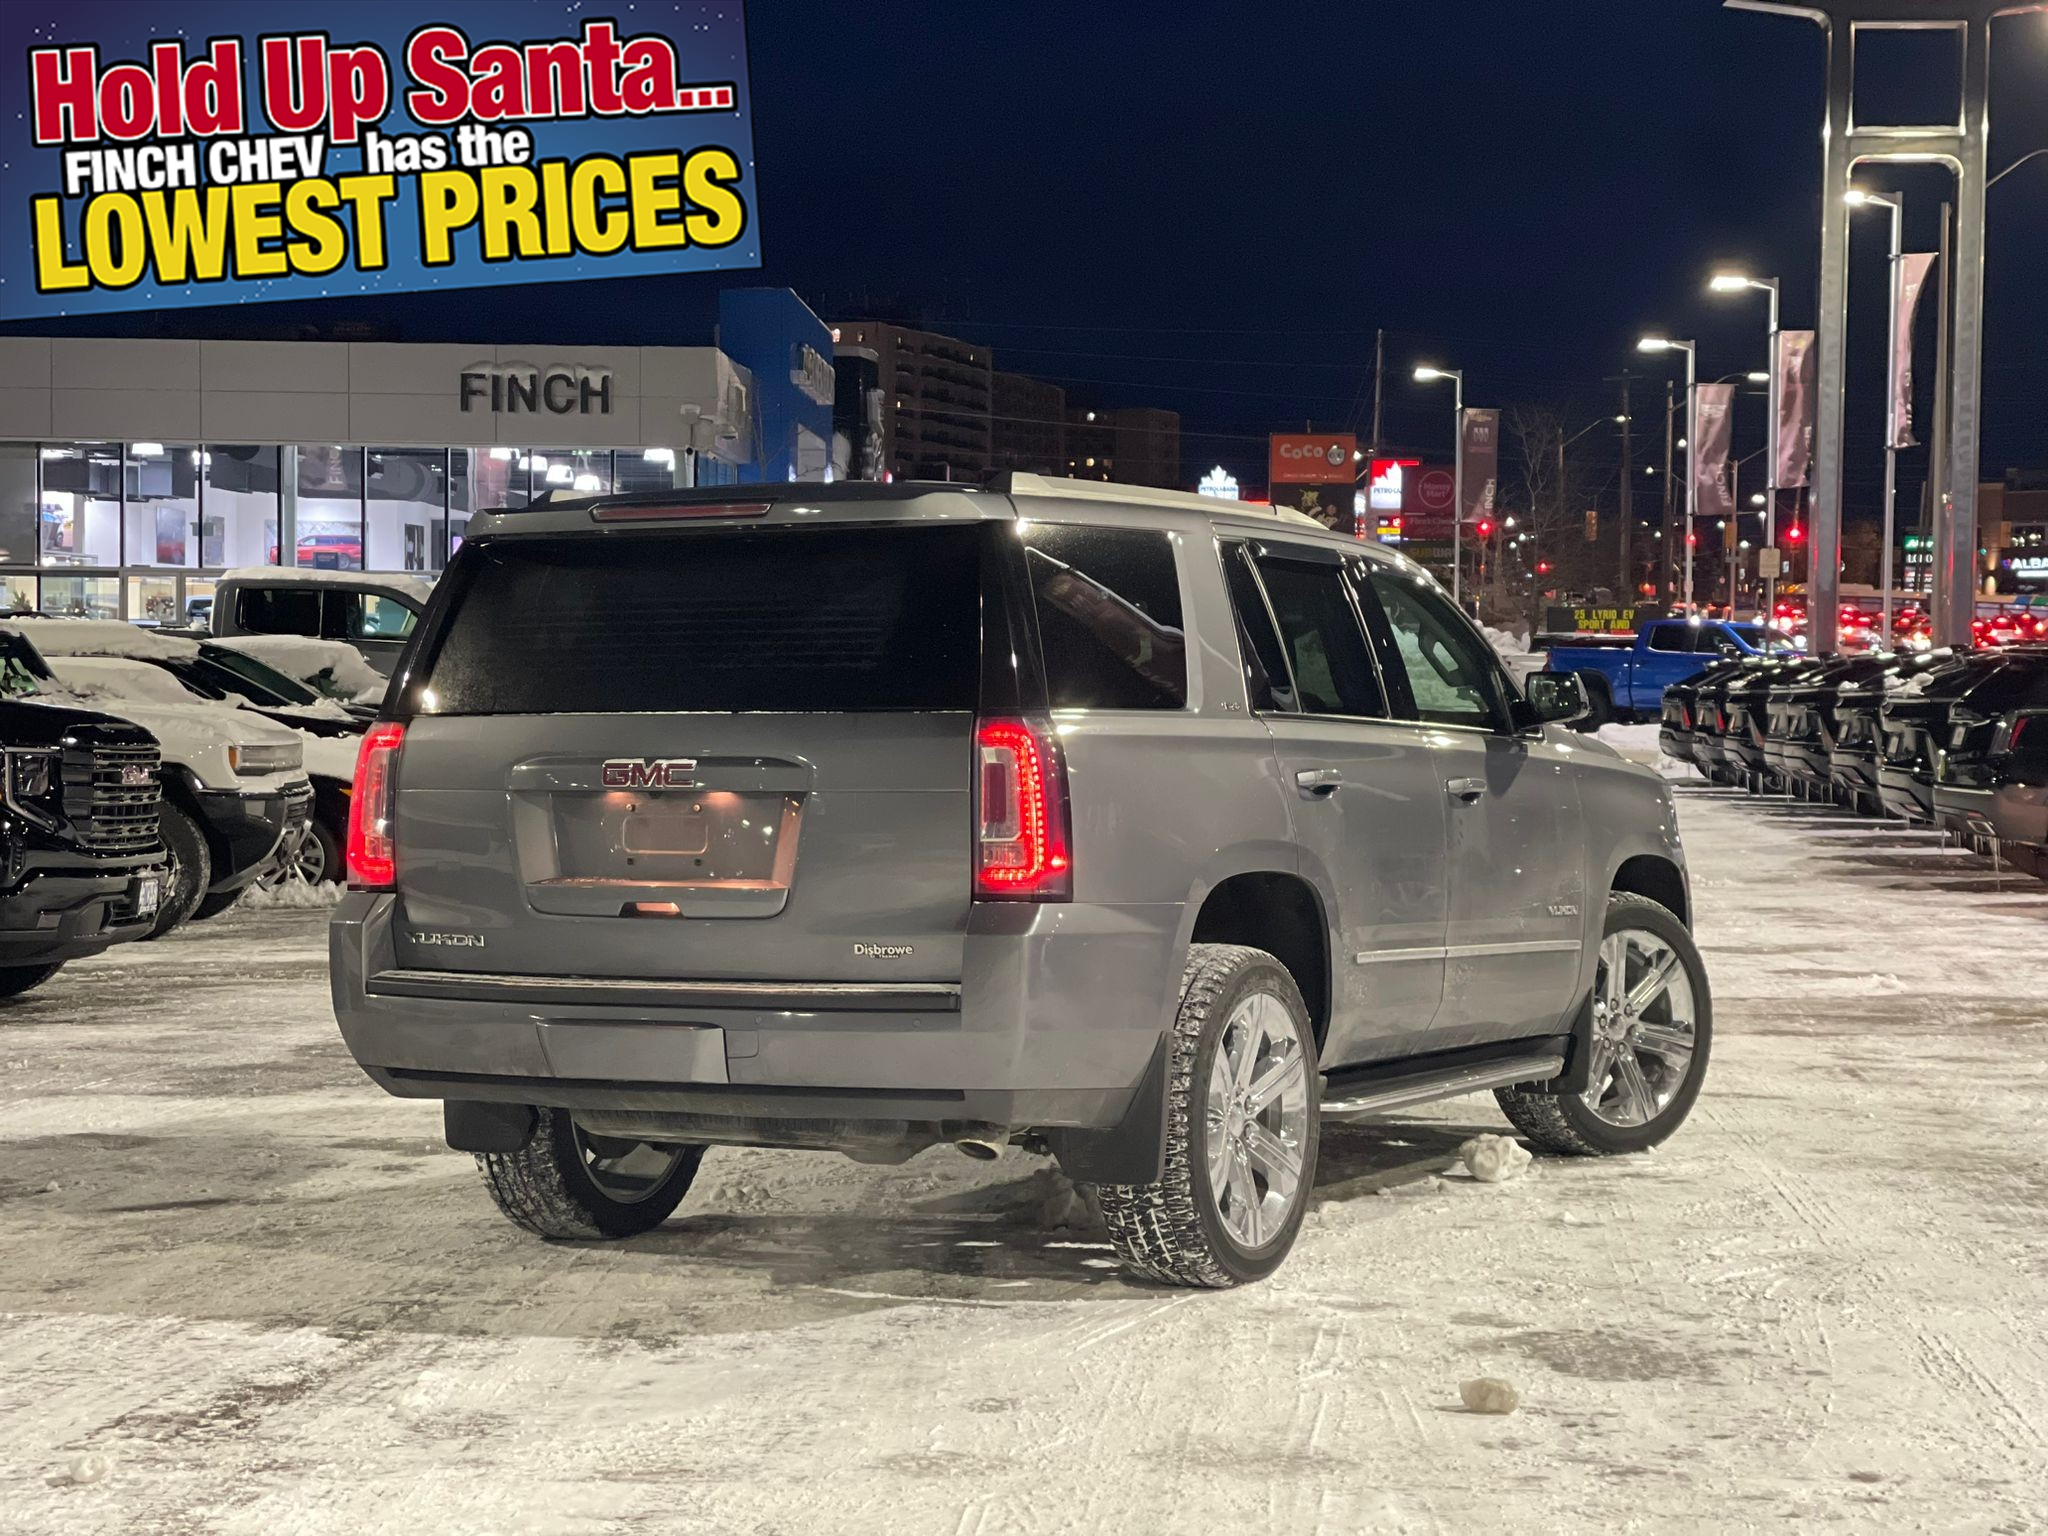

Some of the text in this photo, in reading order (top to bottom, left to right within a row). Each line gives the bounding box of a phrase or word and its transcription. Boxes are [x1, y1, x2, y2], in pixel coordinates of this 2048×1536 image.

[460, 372, 610, 414] FINCH
[1622, 609, 1635, 619] EV
[1578, 620, 1605, 629] SPORT
[602, 760, 696, 788] GMC
[403, 932, 485, 947] YUKON
[854, 943, 913, 955] Disbrowe
